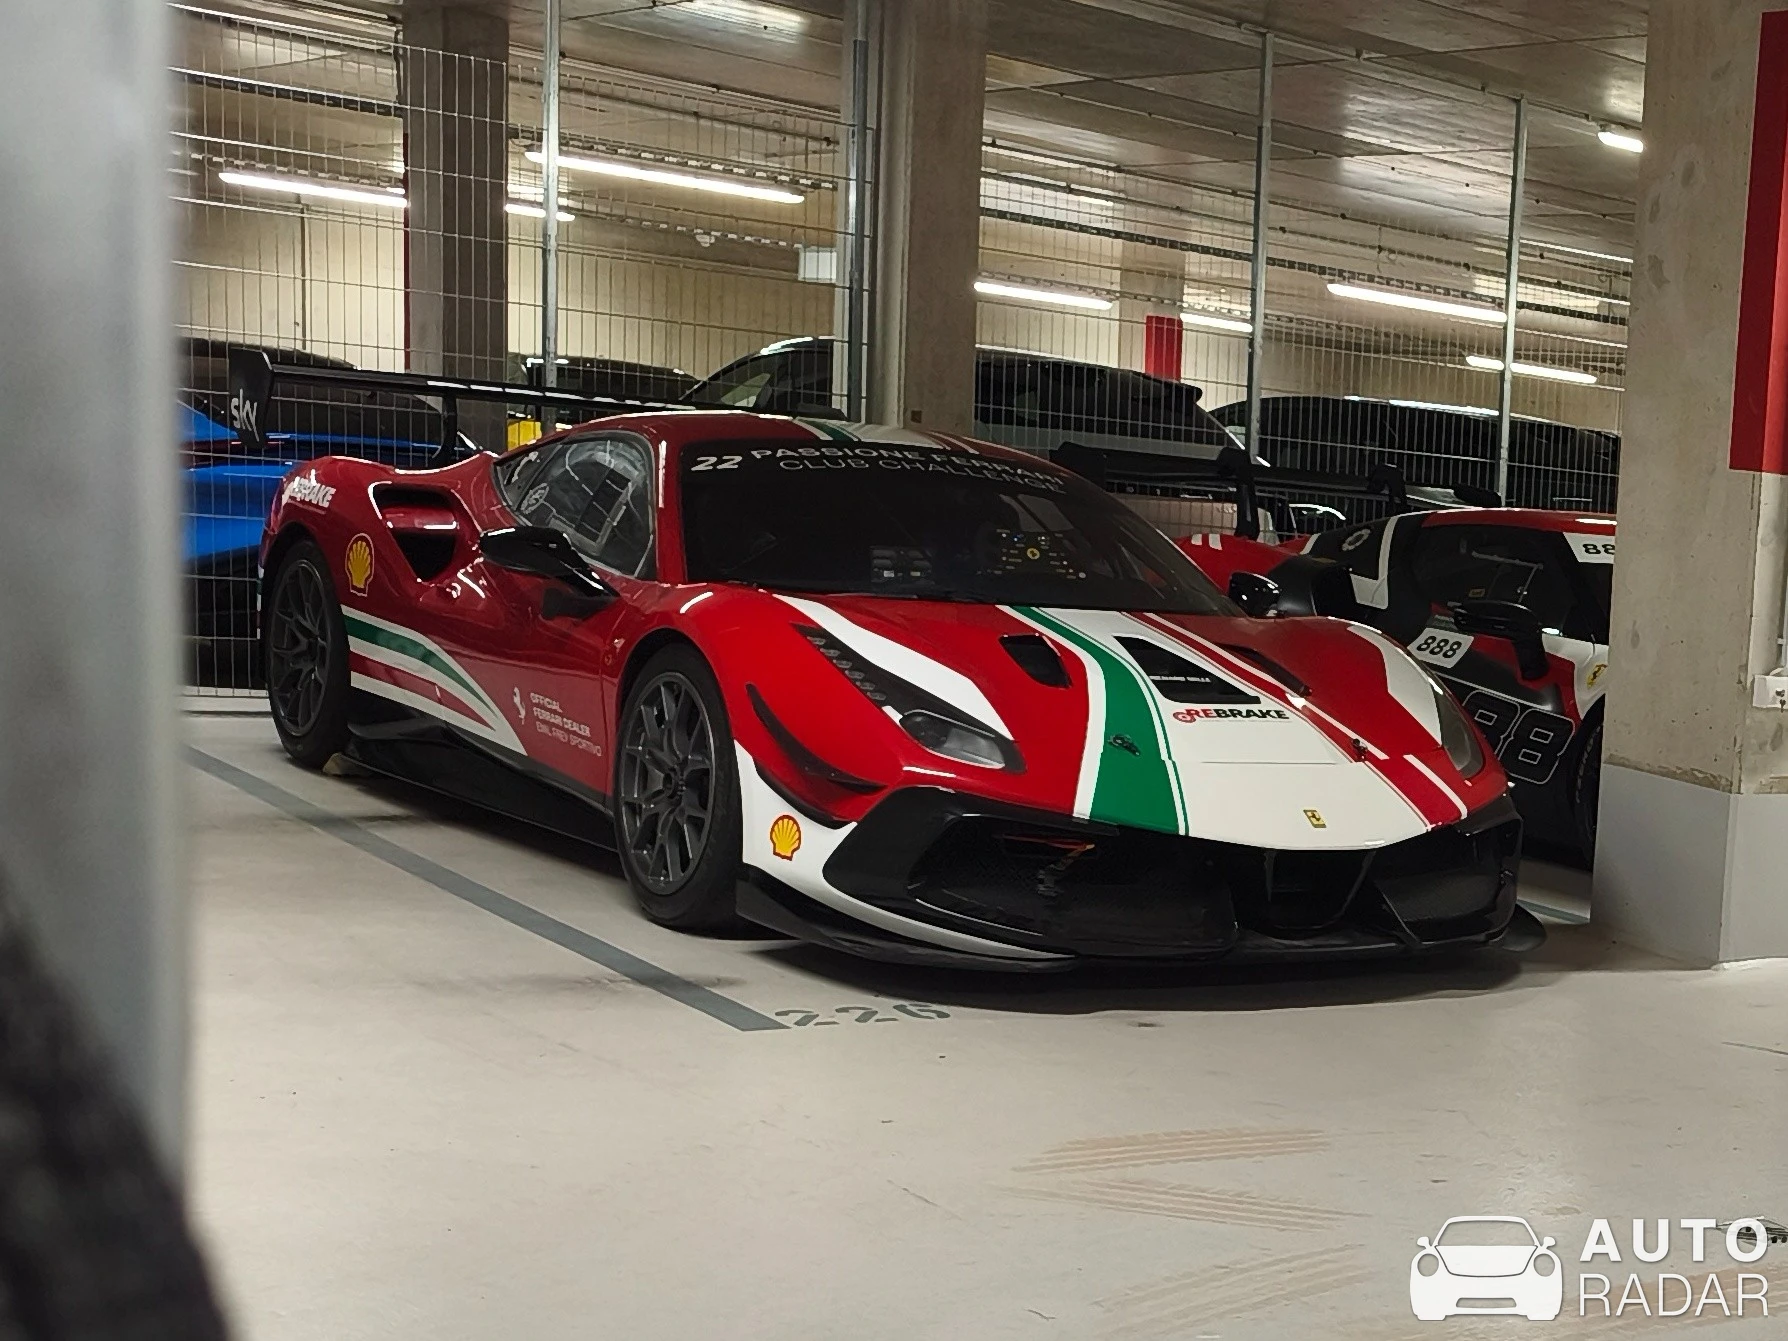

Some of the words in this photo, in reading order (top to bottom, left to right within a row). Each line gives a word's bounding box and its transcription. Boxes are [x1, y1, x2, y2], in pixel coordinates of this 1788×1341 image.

[231, 388, 259, 441] sky
[691, 455, 743, 471] 22
[751, 448, 926, 461] PASSIONE
[779, 458, 870, 470] CLUB
[879, 460, 1067, 494] CHALLENGE
[1416, 635, 1463, 659] 888
[1184, 708, 1290, 720] REBRAKE
[774, 1003, 951, 1027] 226
